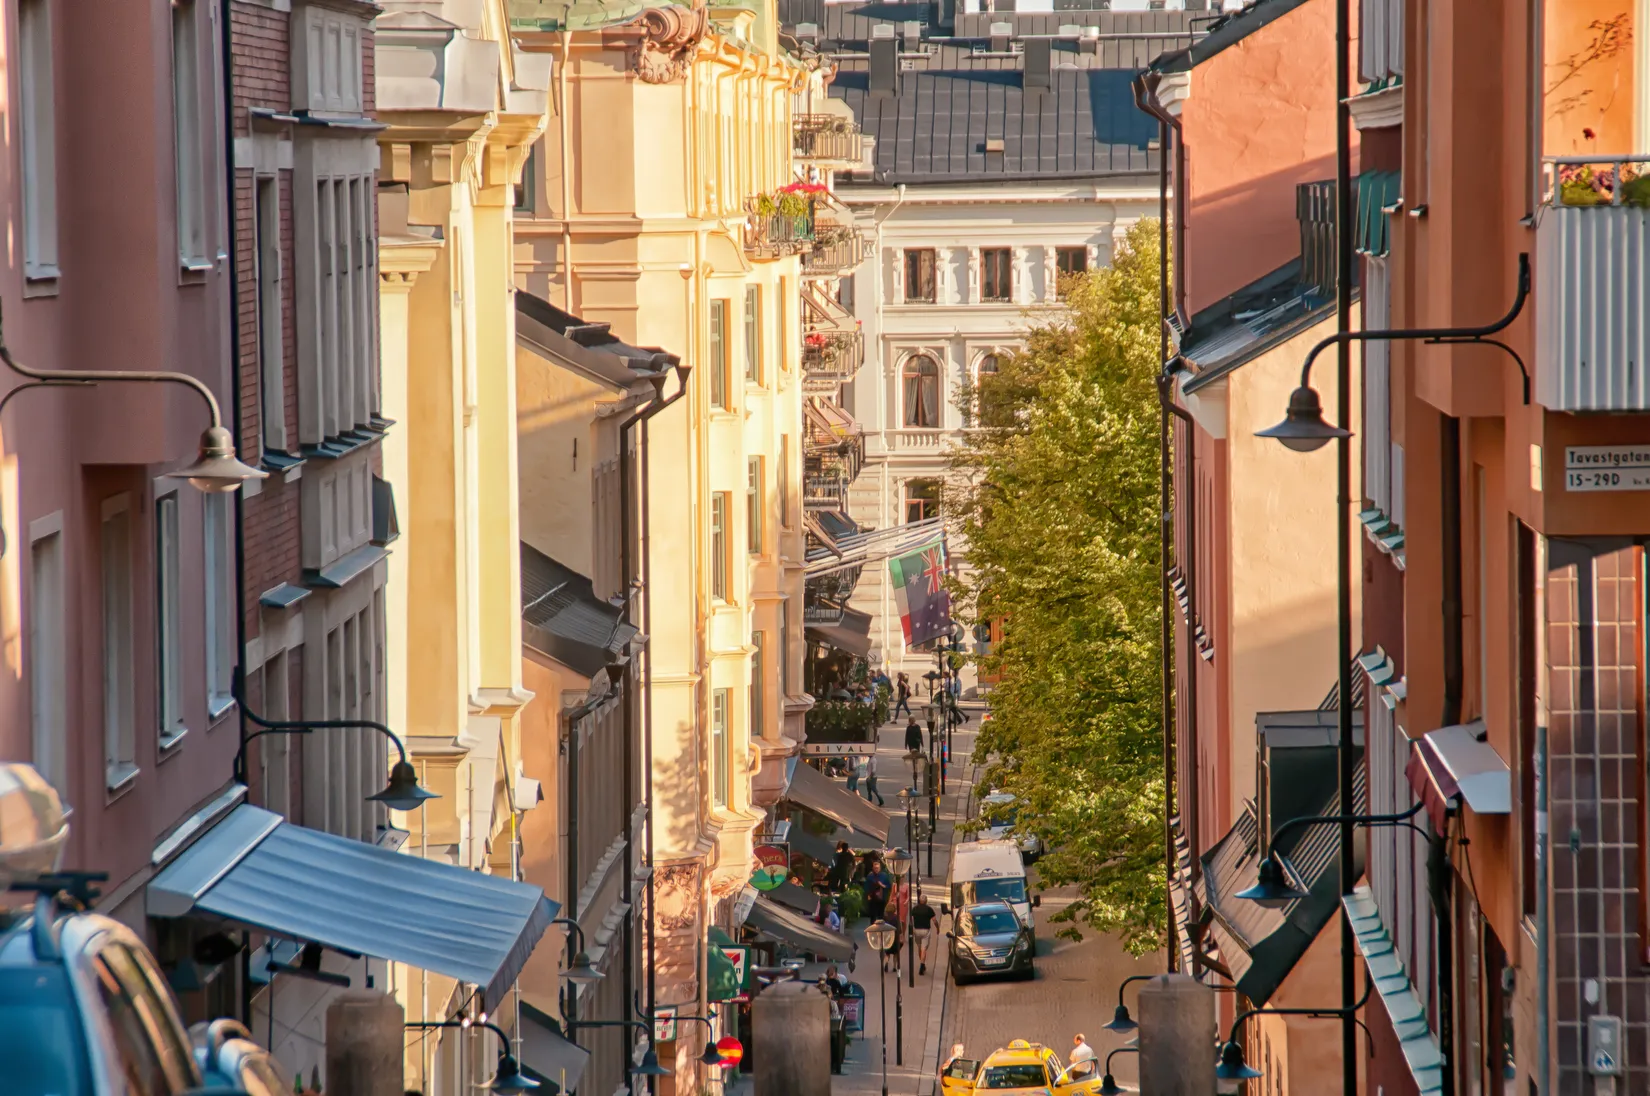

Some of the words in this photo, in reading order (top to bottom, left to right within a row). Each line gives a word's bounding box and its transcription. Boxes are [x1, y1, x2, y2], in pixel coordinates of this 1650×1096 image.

[1569, 451, 1650, 466] Tavastgatan
[1569, 473, 1620, 487] 15-29D
[815, 745, 863, 753] RIVAL
